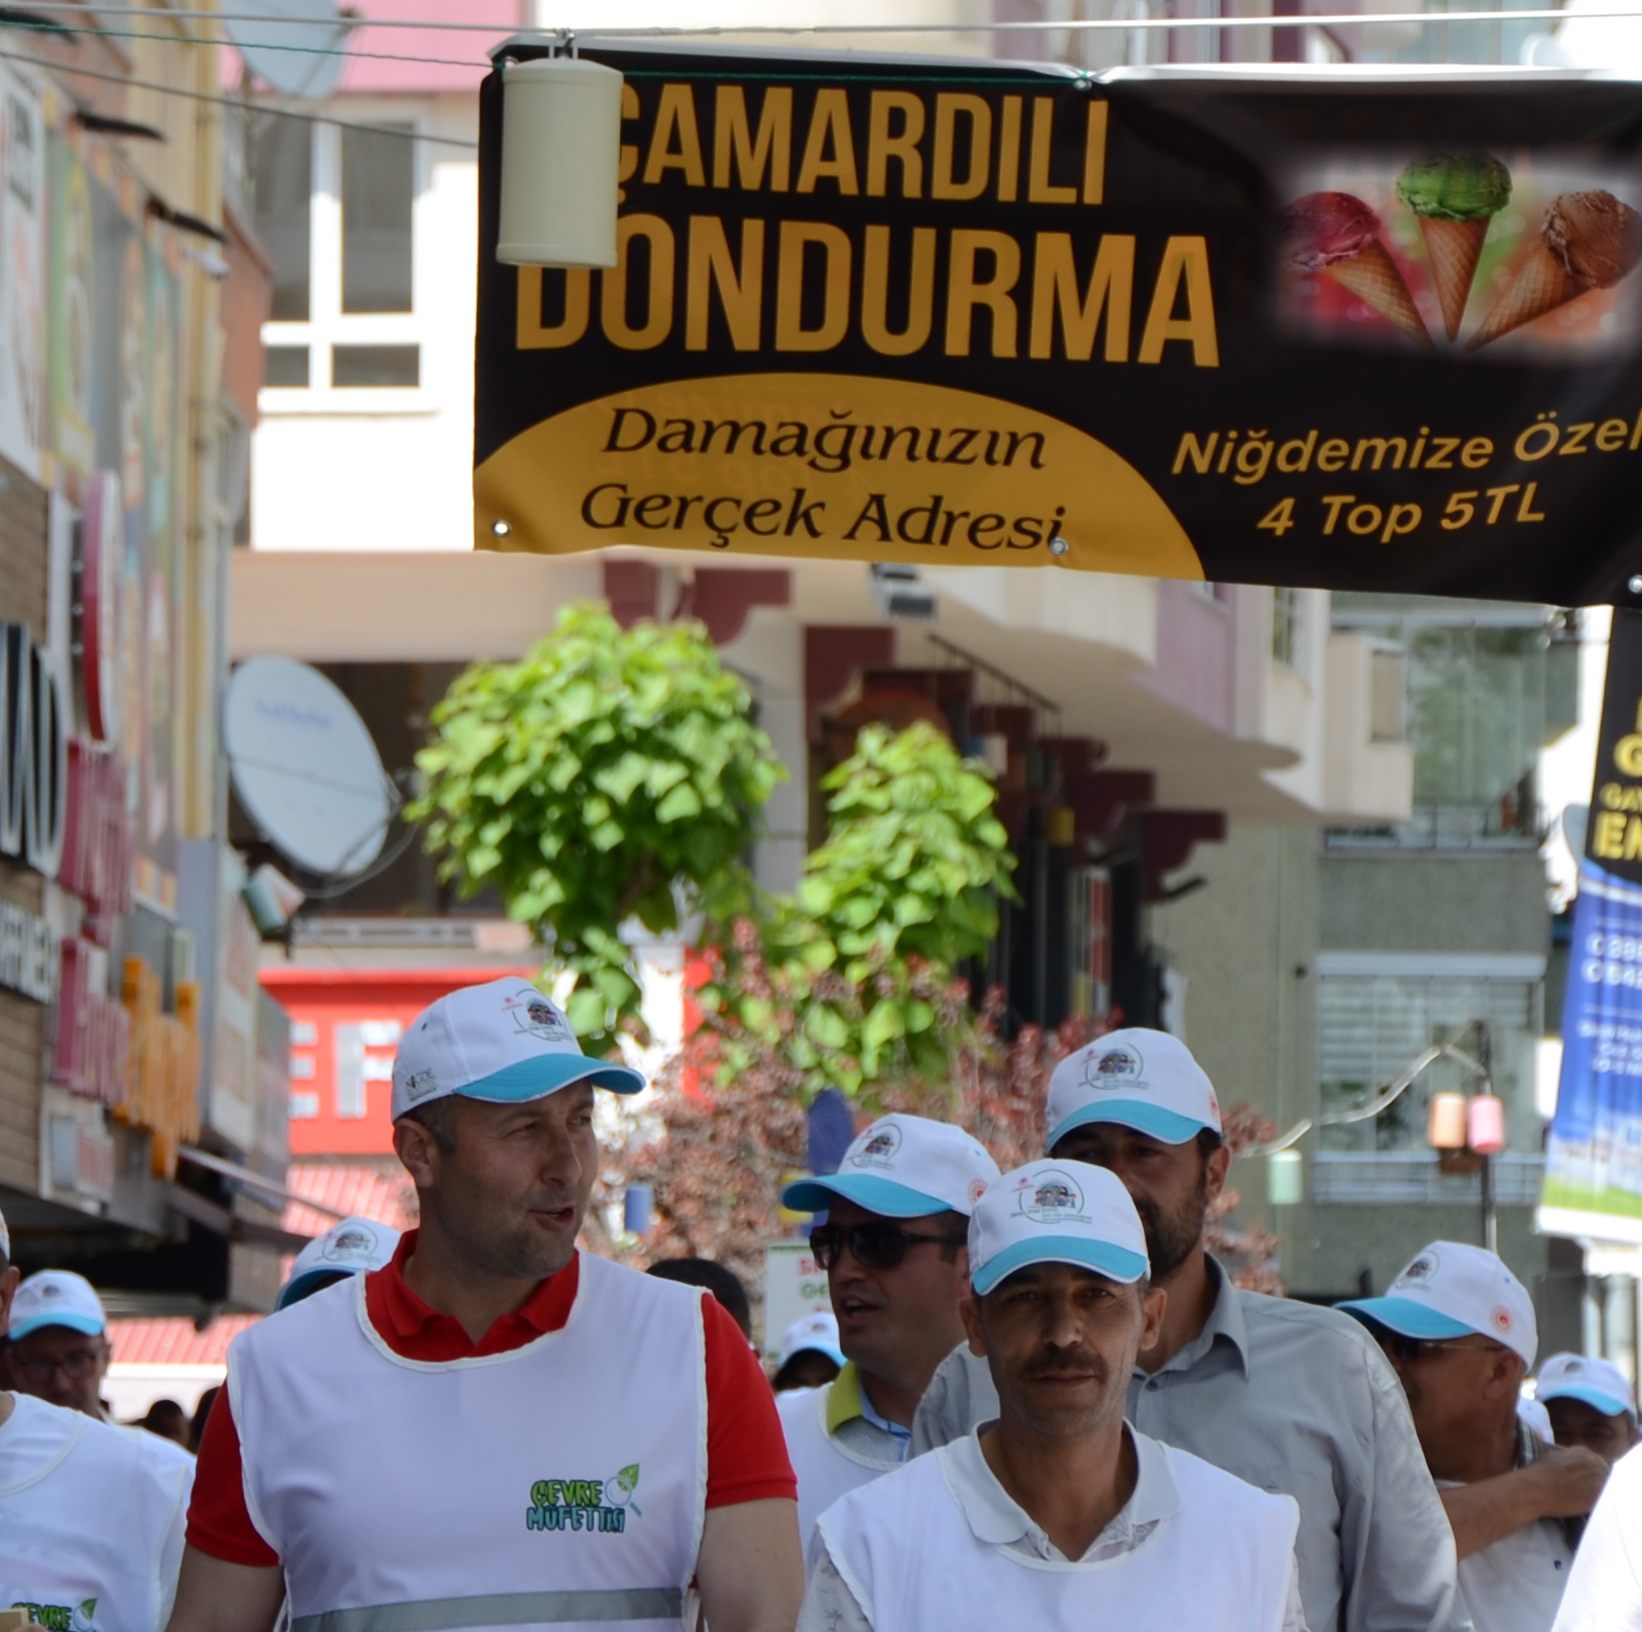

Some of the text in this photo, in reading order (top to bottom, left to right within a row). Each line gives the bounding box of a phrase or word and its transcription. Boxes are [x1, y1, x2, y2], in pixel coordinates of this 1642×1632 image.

[516, 213, 1220, 368] DONDURMA
[602, 407, 1046, 474] Damağınızın
[1172, 426, 1494, 485] Niğdemize
[581, 483, 1066, 550] Gerçek Adresi
[1257, 482, 1546, 543] 4 Top 5TL
[530, 1478, 604, 1509] ÇEVRE
[11, 1602, 73, 1632] EVRE
